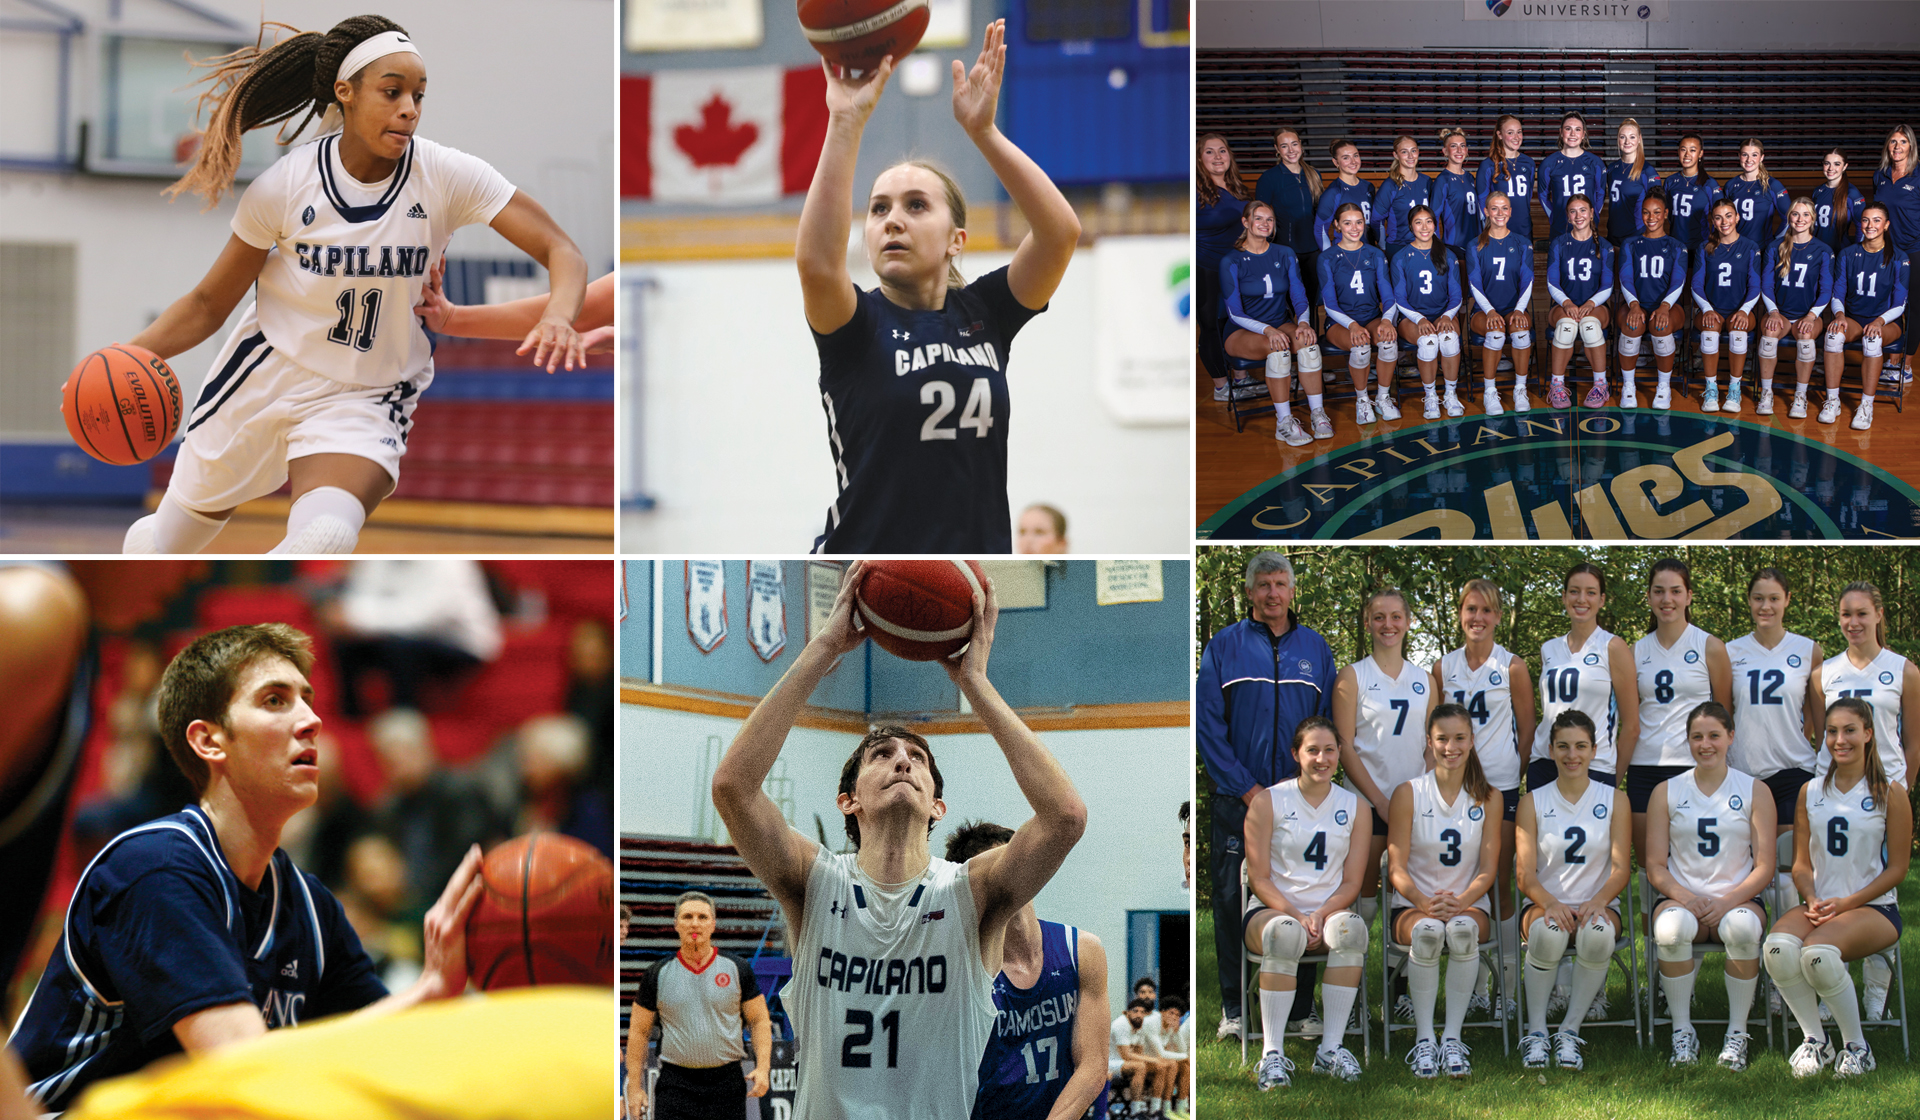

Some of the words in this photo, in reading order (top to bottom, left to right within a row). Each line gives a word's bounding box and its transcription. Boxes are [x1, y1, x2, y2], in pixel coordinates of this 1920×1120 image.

[1523, 4, 1630, 16] UNIVERSITY
[1507, 174, 1528, 197] 16
[1562, 174, 1586, 197] 12
[1361, 201, 1371, 225] 6
[1466, 191, 1477, 215] 8
[1672, 193, 1694, 217] 15
[1815, 204, 1831, 228] 8
[295, 242, 430, 277] CAPILANO
[1492, 256, 1506, 280] 7
[1567, 257, 1592, 281] 13
[1639, 254, 1664, 278] 10
[1718, 262, 1732, 287] 2
[1781, 263, 1808, 288] 17
[1263, 273, 1274, 299] 1
[1350, 270, 1364, 295] 4
[1418, 269, 1433, 295] 3
[1856, 271, 1877, 297] 11
[327, 288, 383, 352] 11
[895, 342, 999, 376] CAPILANO
[126, 371, 157, 442] EVOLUTION
[920, 377, 994, 441] 24
[1250, 416, 1622, 531] CAPILANO
[1547, 667, 1580, 703] 10
[1654, 669, 1675, 704] 8
[1746, 669, 1785, 705] 12
[1389, 699, 1409, 736] 7
[1838, 689, 1874, 718] 5
[1303, 831, 1327, 870] 4
[1439, 828, 1461, 867] 3
[1564, 826, 1586, 864] 2
[1697, 818, 1720, 857] 5
[1827, 816, 1849, 857] 6
[818, 947, 946, 995] CAPILANO
[841, 1008, 900, 1069] 21
[1021, 1036, 1059, 1084] 17
